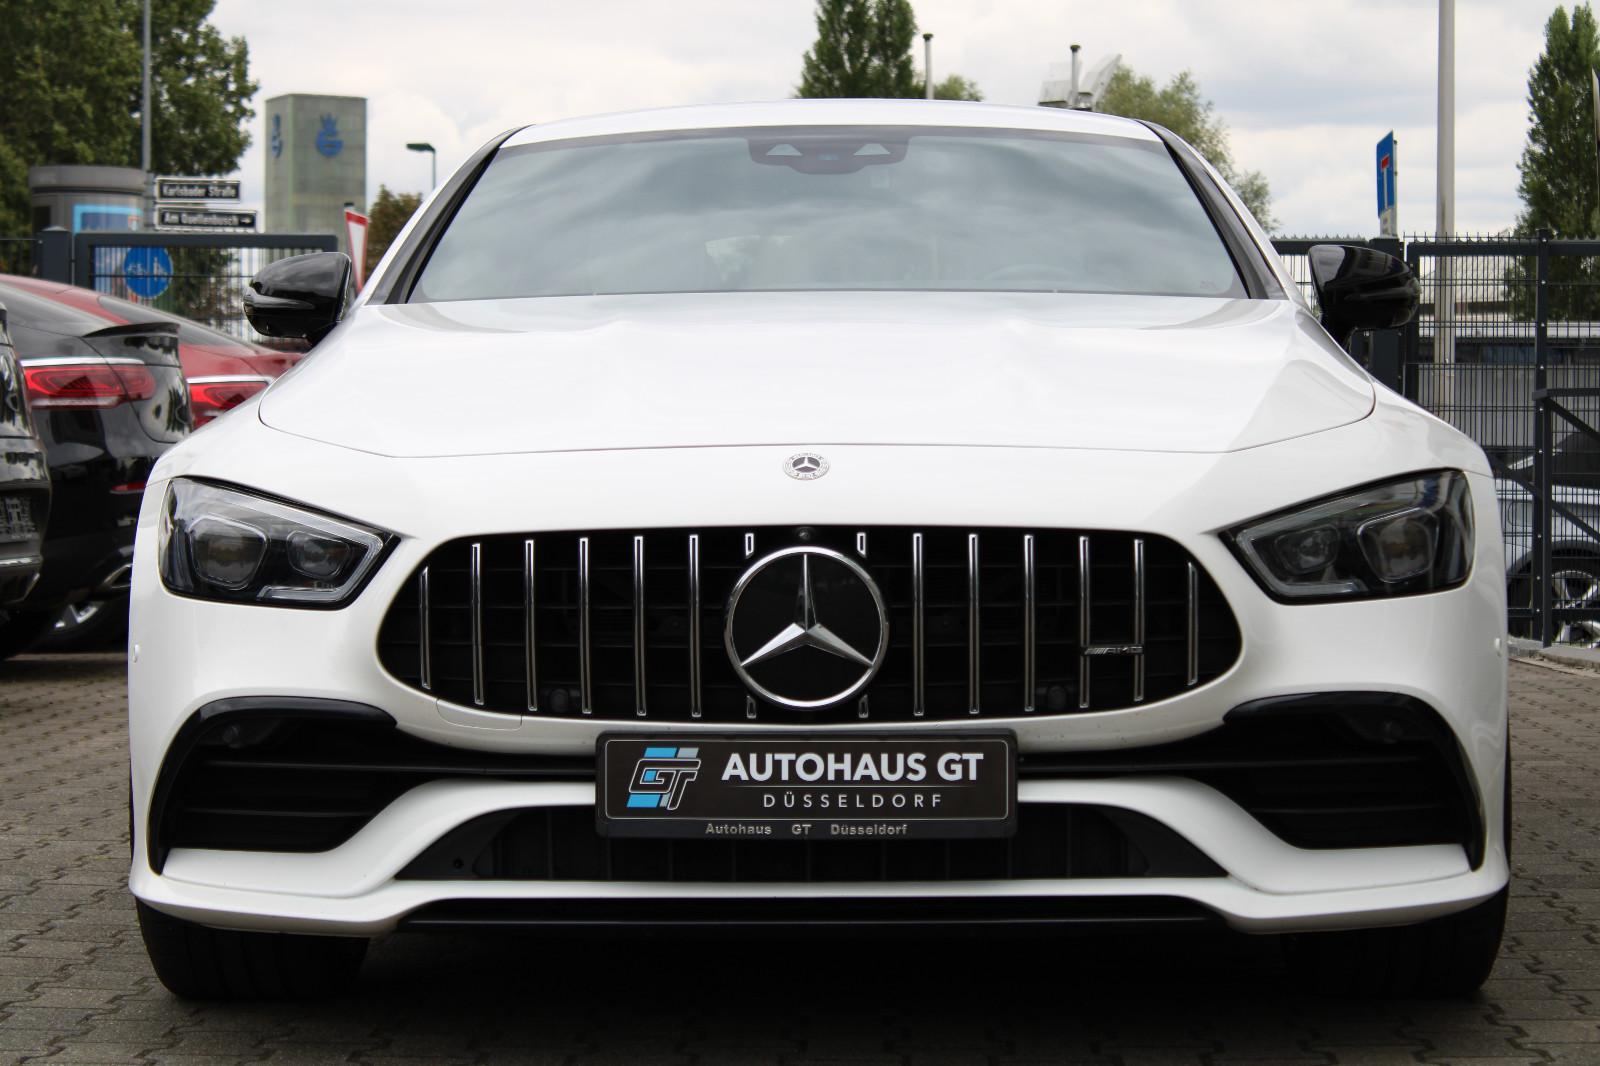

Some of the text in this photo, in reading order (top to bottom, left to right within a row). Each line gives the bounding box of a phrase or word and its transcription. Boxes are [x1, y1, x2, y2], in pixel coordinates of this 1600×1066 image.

[164, 212, 180, 224] Am
[721, 752, 984, 782] AUTOHAUS GT
[763, 791, 942, 808] DÜSSELDORF
[705, 823, 908, 835] Autohaus GT Düsseldorf
